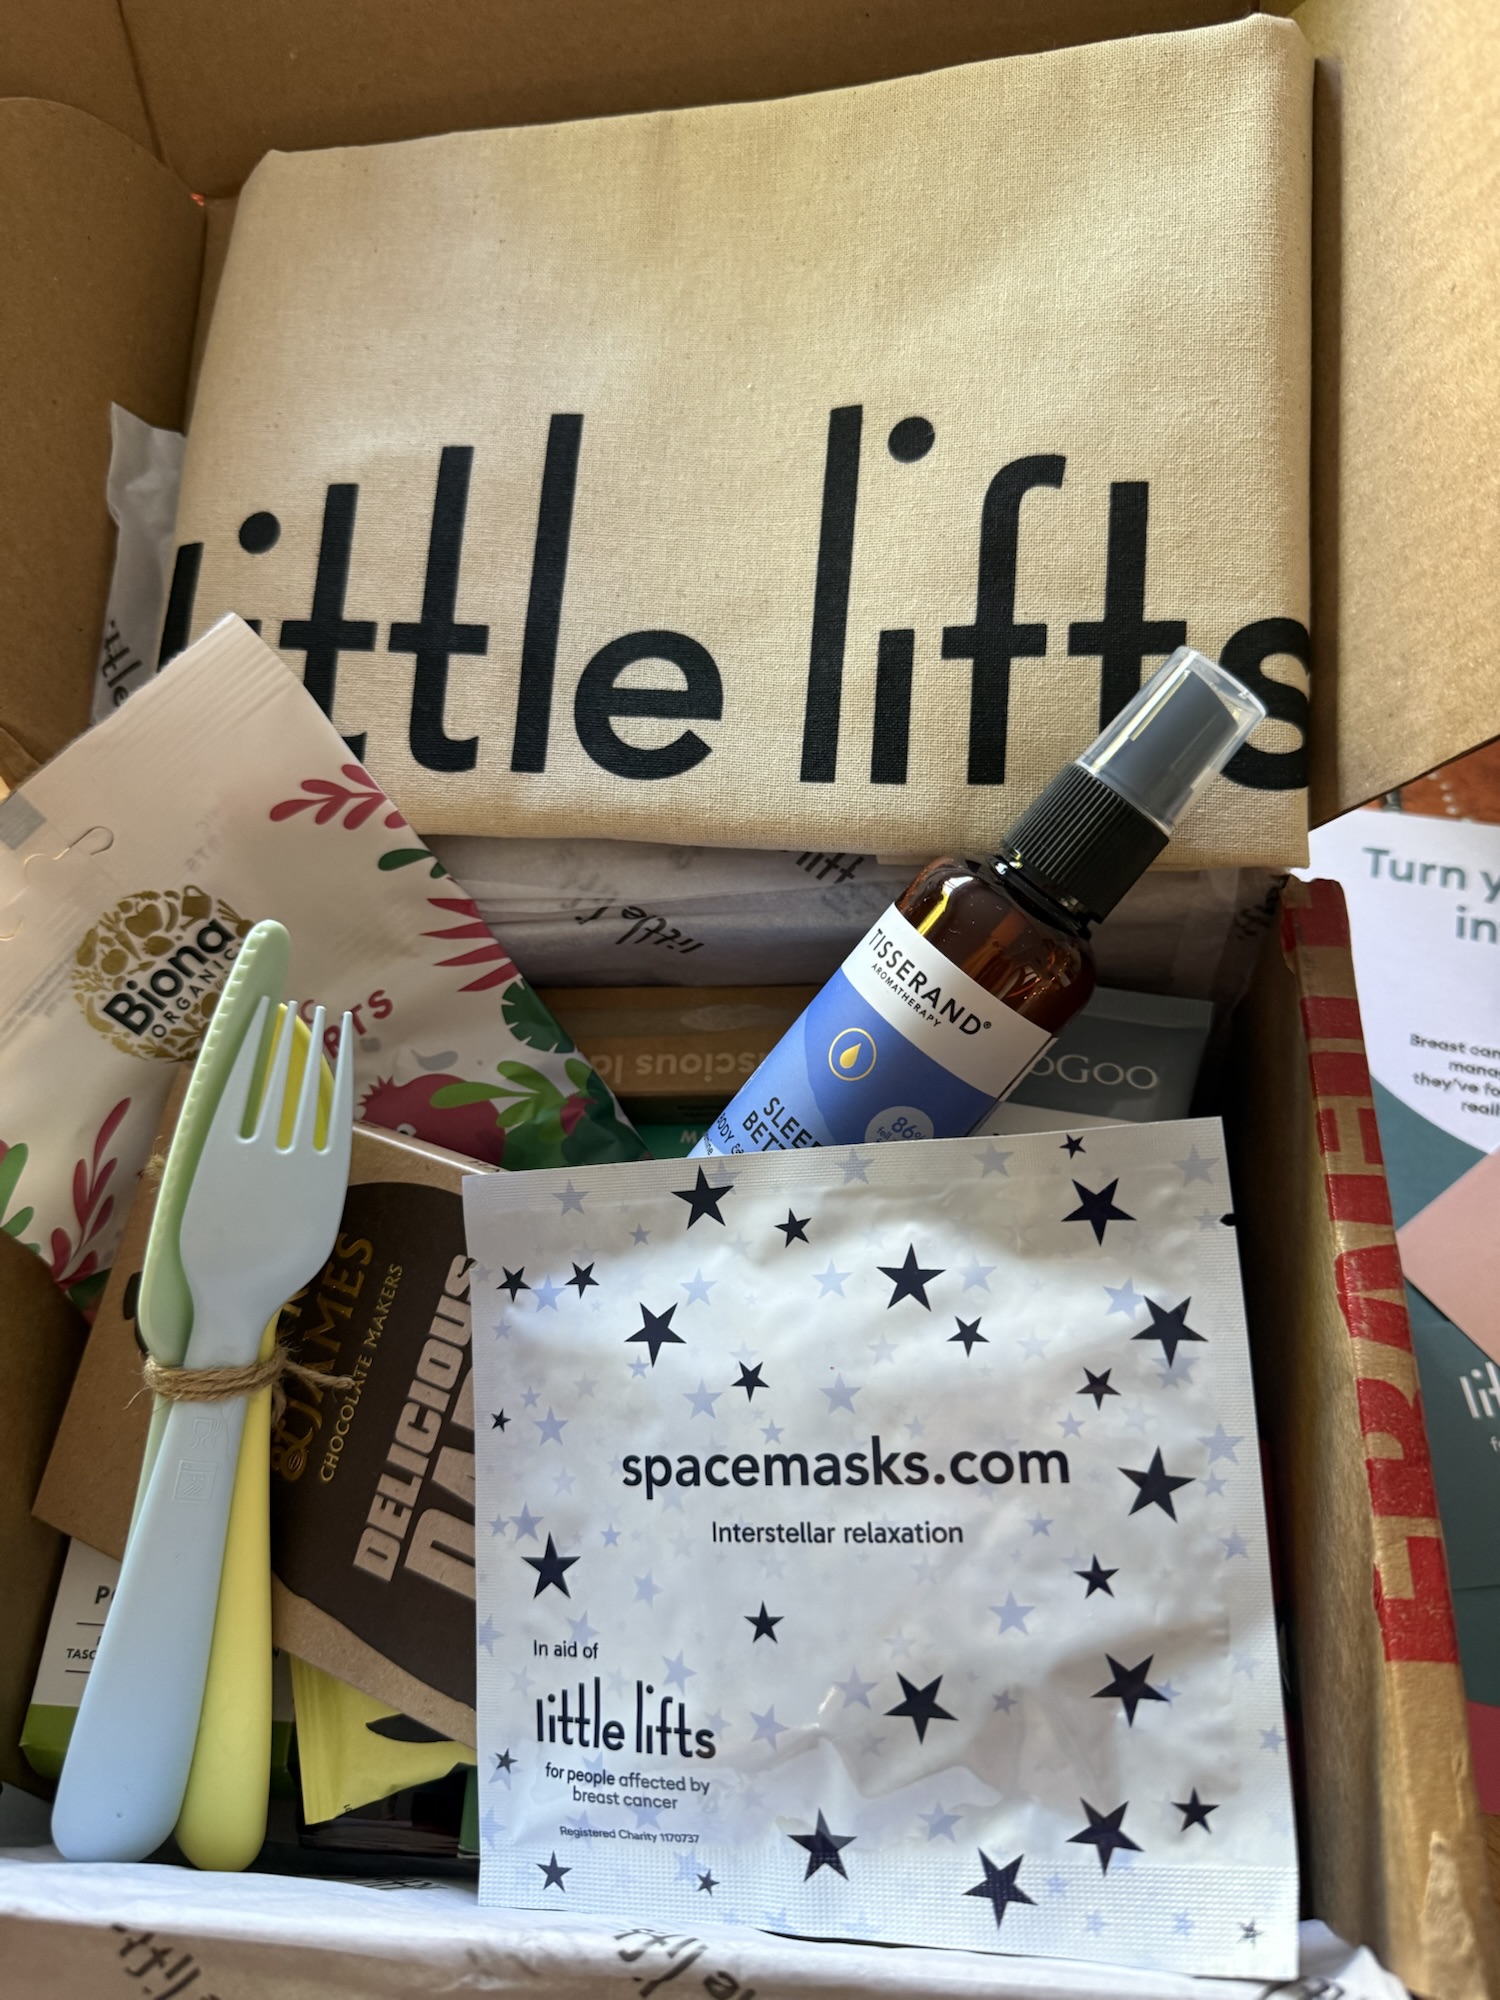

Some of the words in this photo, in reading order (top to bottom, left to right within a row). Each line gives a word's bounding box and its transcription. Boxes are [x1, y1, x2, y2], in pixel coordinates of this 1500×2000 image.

[800, 405, 1310, 790] lifts
[1362, 847, 1466, 891] Turn
[621, 905, 705, 954] little
[1456, 904, 1500, 945] in
[103, 918, 236, 1036] Biona
[151, 948, 239, 1038] ORGANIC
[871, 962, 942, 1028] AROMATHERAPY
[1409, 1033, 1466, 1054] Breast
[636, 1052, 764, 1083] scious
[1413, 1072, 1479, 1093] they've
[1448, 1061, 1500, 1080] mana
[763, 1097, 822, 1149] SLEE
[319, 1354, 374, 1484] CHOCOLATE
[363, 1262, 404, 1349] MAKERS
[352, 1253, 475, 1583] DELICIOUS
[621, 1435, 1071, 1500] spacemasks.com
[711, 1521, 836, 1545] Interstellar
[843, 1520, 965, 1545] relaxation
[533, 1639, 548, 1657] In
[553, 1641, 578, 1658] aid
[582, 1642, 599, 1659] of
[536, 1676, 626, 1751] little
[635, 1680, 718, 1759] lifts
[545, 1762, 565, 1779] for
[567, 1768, 616, 1788] people
[618, 1773, 687, 1792] affected
[690, 1777, 711, 1795] by
[572, 1785, 620, 1806] breast
[622, 1794, 679, 1810] cancer
[559, 1825, 617, 1840] Registered
[617, 1828, 658, 1844] Charity
[659, 1833, 700, 1844] 1170737
